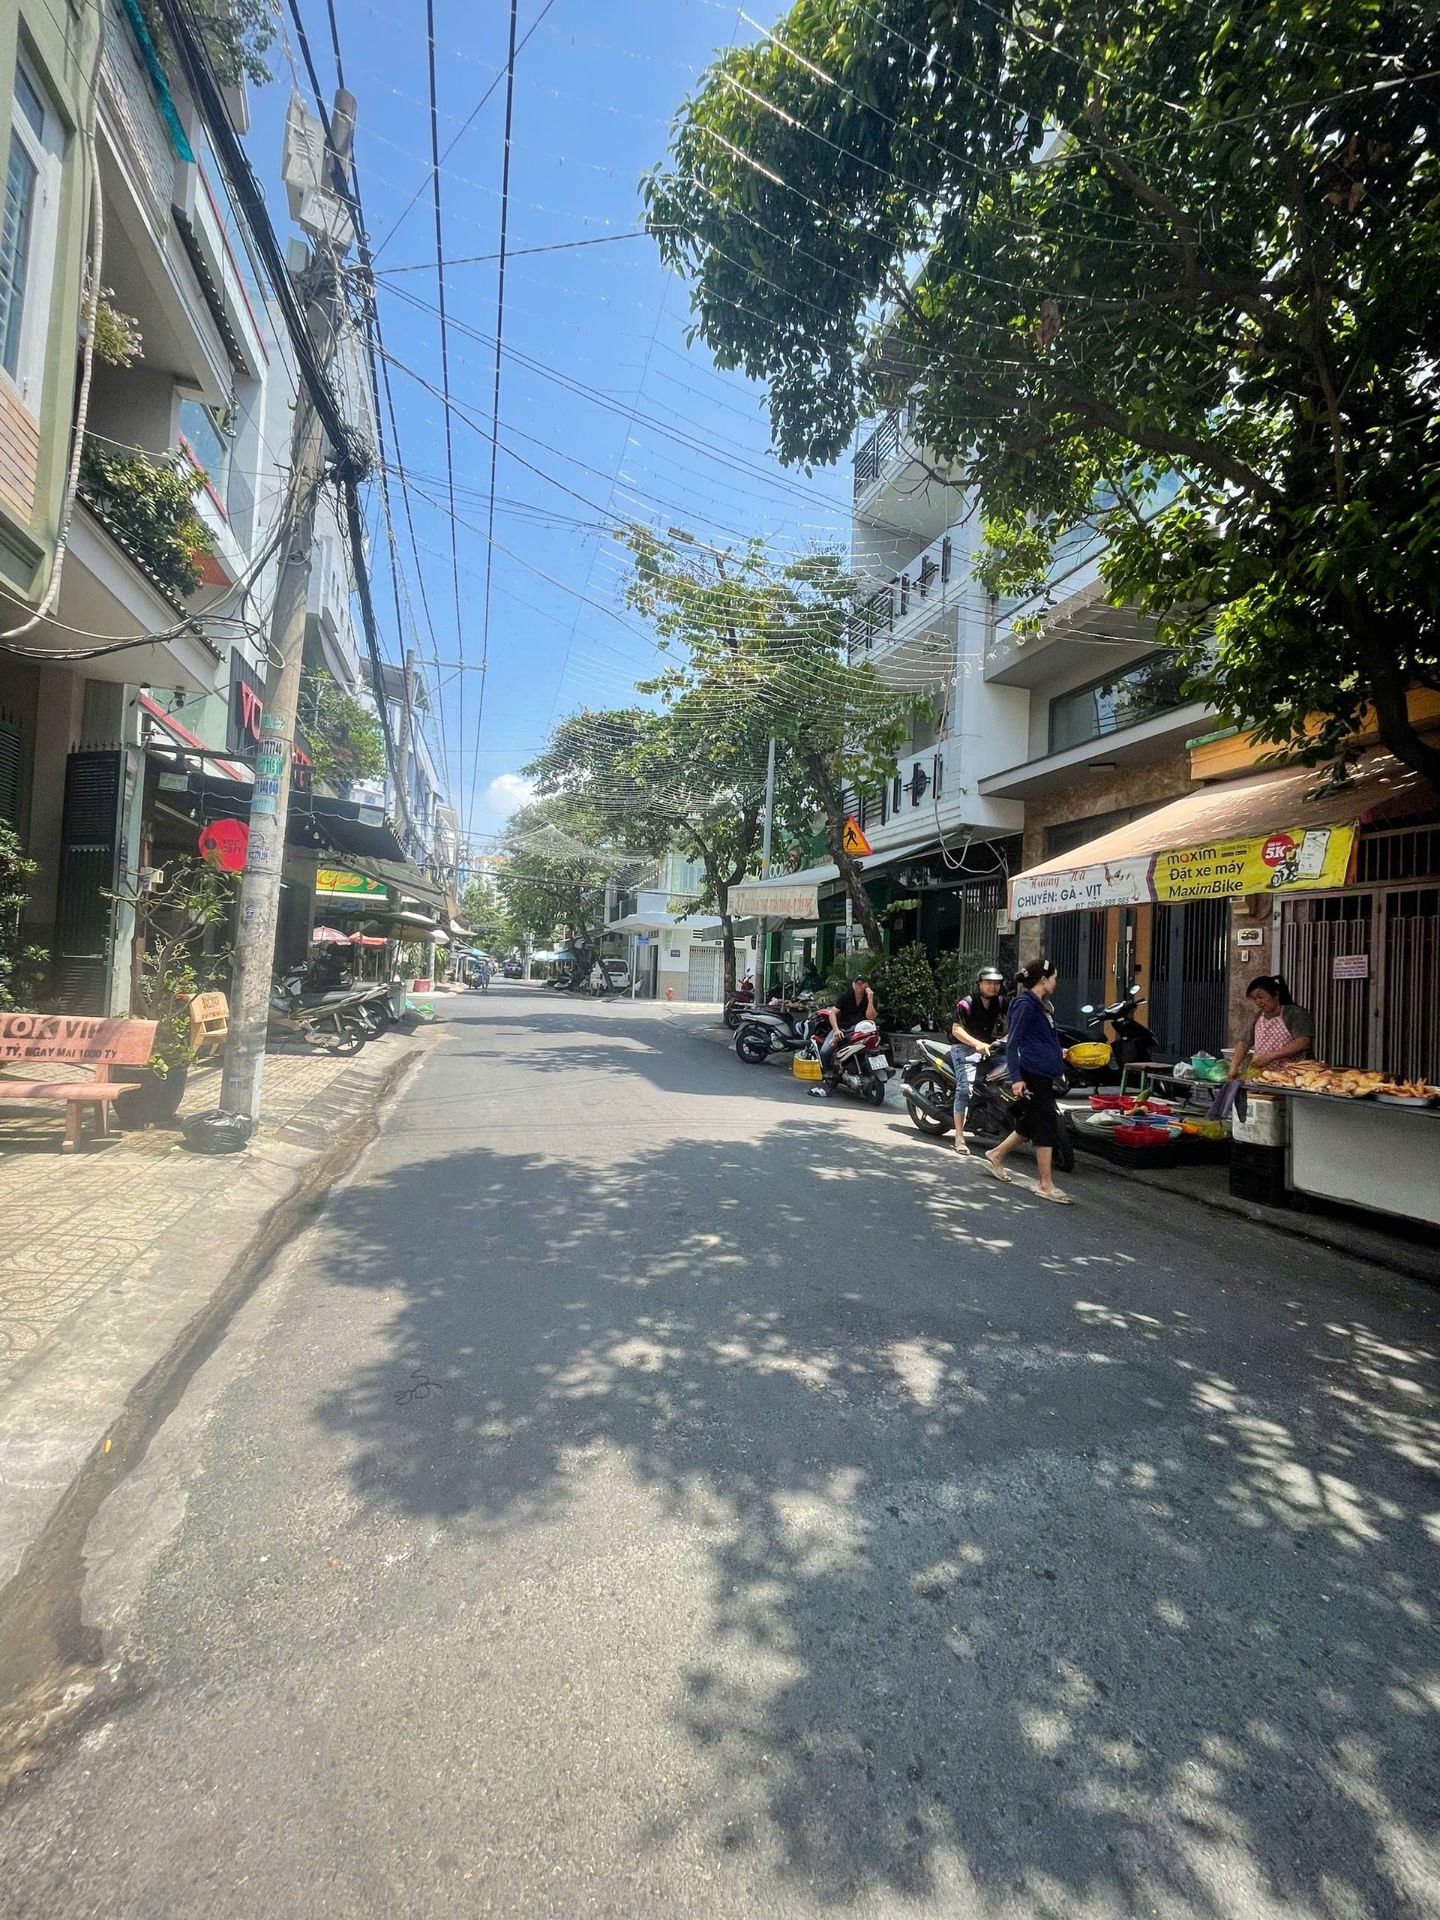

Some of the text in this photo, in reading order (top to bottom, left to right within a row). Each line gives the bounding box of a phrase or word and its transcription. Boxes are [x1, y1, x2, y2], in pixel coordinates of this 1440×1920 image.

[1167, 848, 1217, 866] maxim
[1265, 846, 1286, 859] 5K
[1169, 859, 1245, 882] Đặt xe máy
[1060, 885, 1077, 901] GÀ
[1085, 883, 1103, 900] VỊT
[1168, 880, 1244, 899] MaximBike
[10, 1016, 59, 1039] OK
